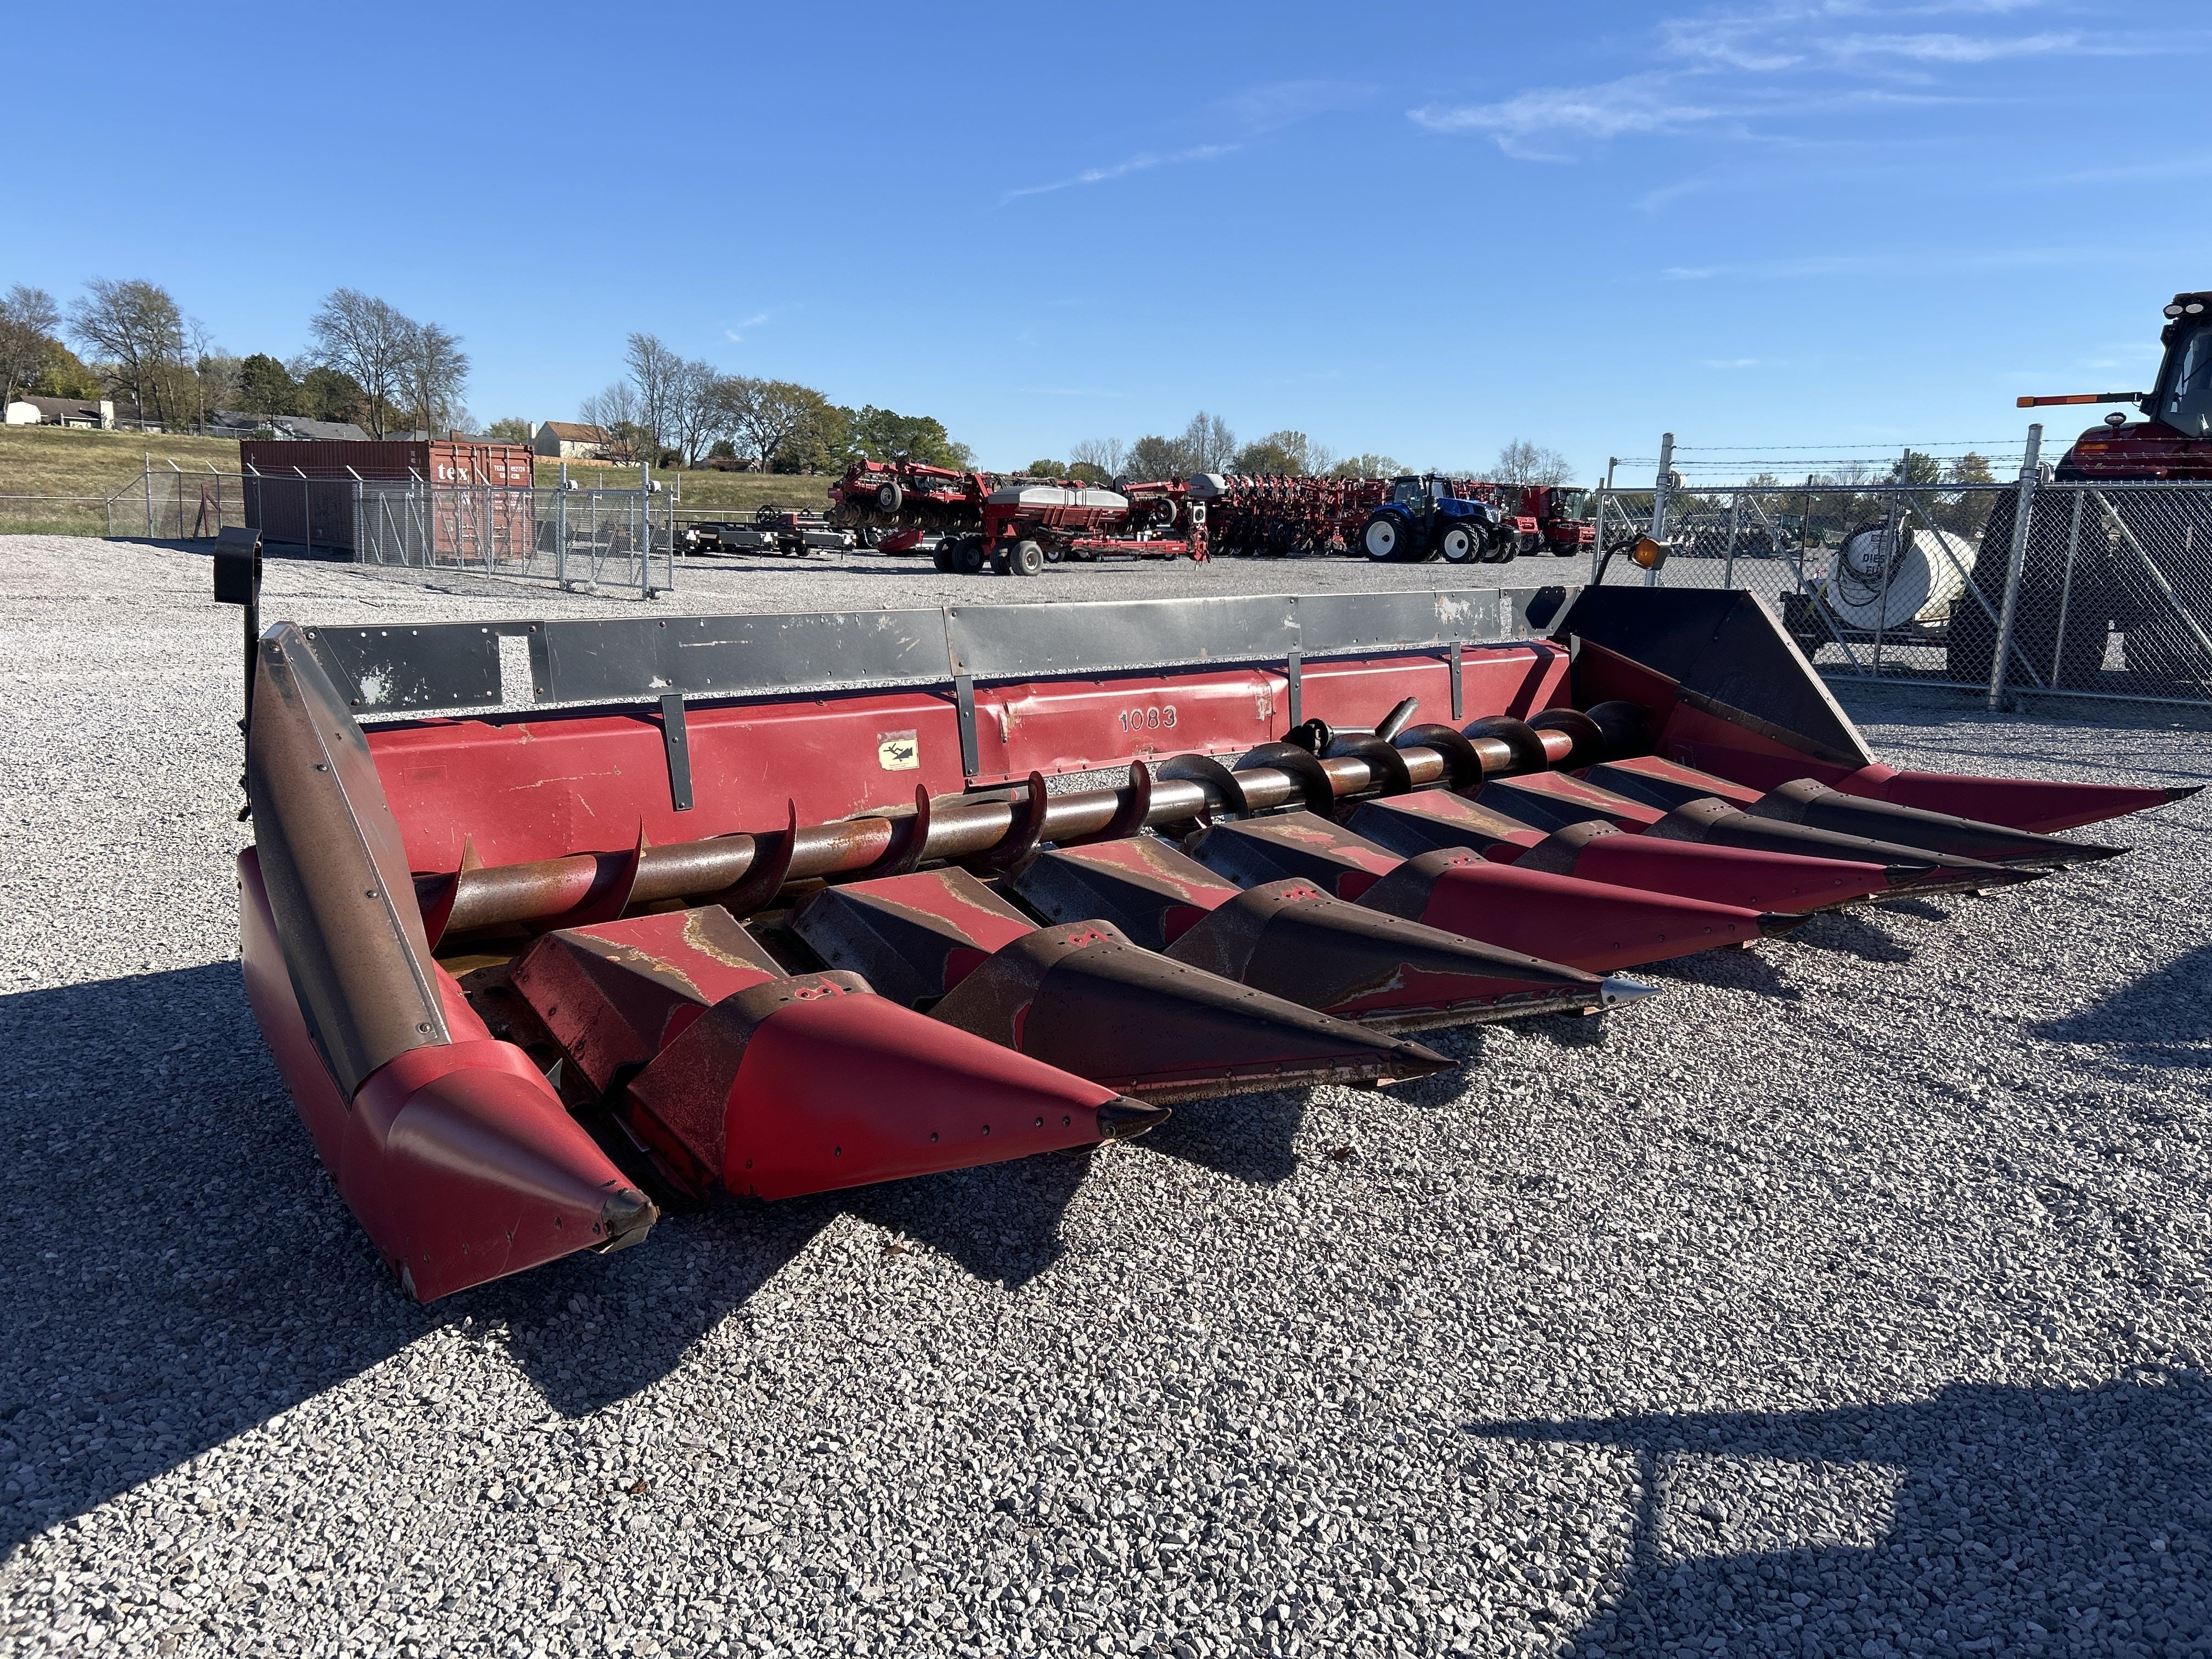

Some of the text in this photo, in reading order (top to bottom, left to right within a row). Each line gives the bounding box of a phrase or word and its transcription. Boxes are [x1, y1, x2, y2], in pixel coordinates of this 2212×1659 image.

[437, 462, 469, 481] tex
[1862, 554, 1886, 563] DIES
[1866, 565, 1886, 574] FU
[1118, 704, 1177, 733] 1083
